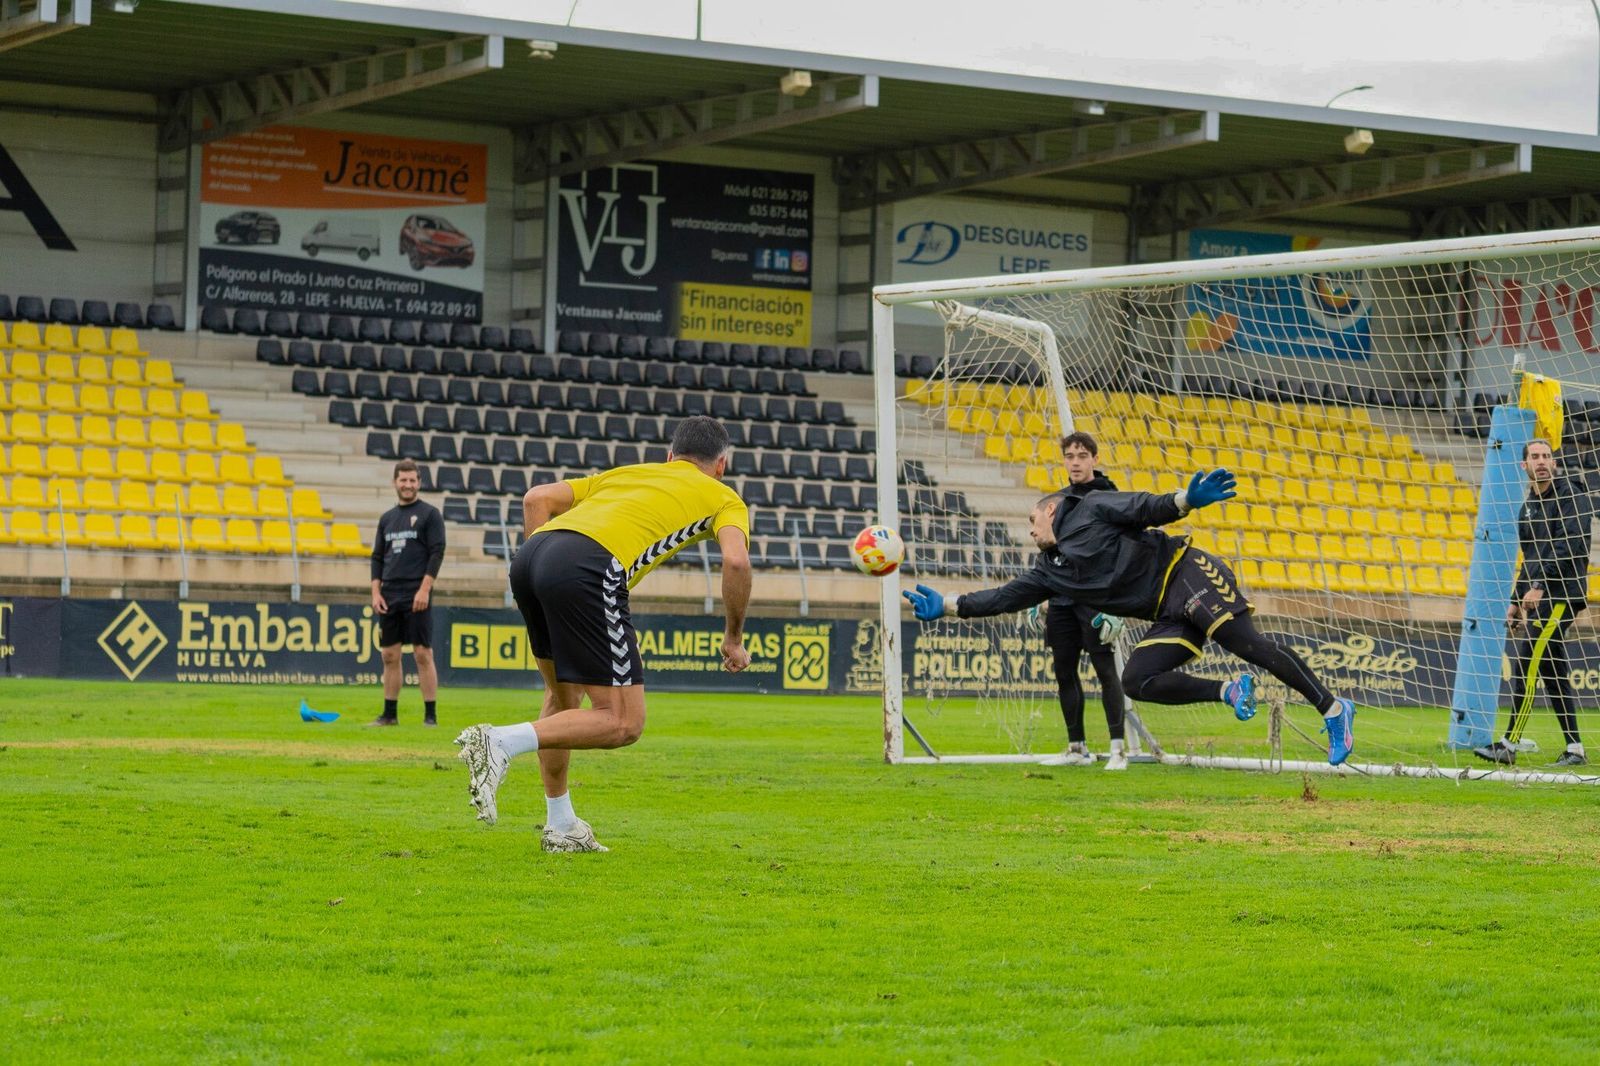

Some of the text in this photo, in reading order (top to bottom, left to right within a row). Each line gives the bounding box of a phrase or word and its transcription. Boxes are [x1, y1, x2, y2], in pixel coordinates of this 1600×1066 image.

[323, 140, 469, 195] Jacomé
[963, 224, 1088, 252] DESGUACES
[1199, 241, 1237, 256] Amor
[259, 268, 270, 282] el
[272, 269, 307, 285] Prado
[347, 275, 373, 290] Cruz
[280, 290, 295, 304] 28
[305, 292, 330, 307] LEPE
[340, 295, 384, 311] HUELVA
[406, 300, 428, 314] 694
[430, 301, 445, 315] 22
[447, 302, 462, 316] 89
[464, 304, 476, 318] 21
[556, 303, 663, 323] Ventanas Jacomé
[680, 311, 706, 331] sin
[460, 633, 517, 660] Bd
[634, 629, 780, 658] ALMERAS
[177, 652, 267, 667] HUELVA
[647, 659, 705, 672] especialista
[706, 661, 719, 671] en
[913, 653, 1003, 679] POLLOS
[1008, 654, 1025, 679] Y
[356, 673, 377, 684] 959
[1365, 675, 1405, 691] Huelva
